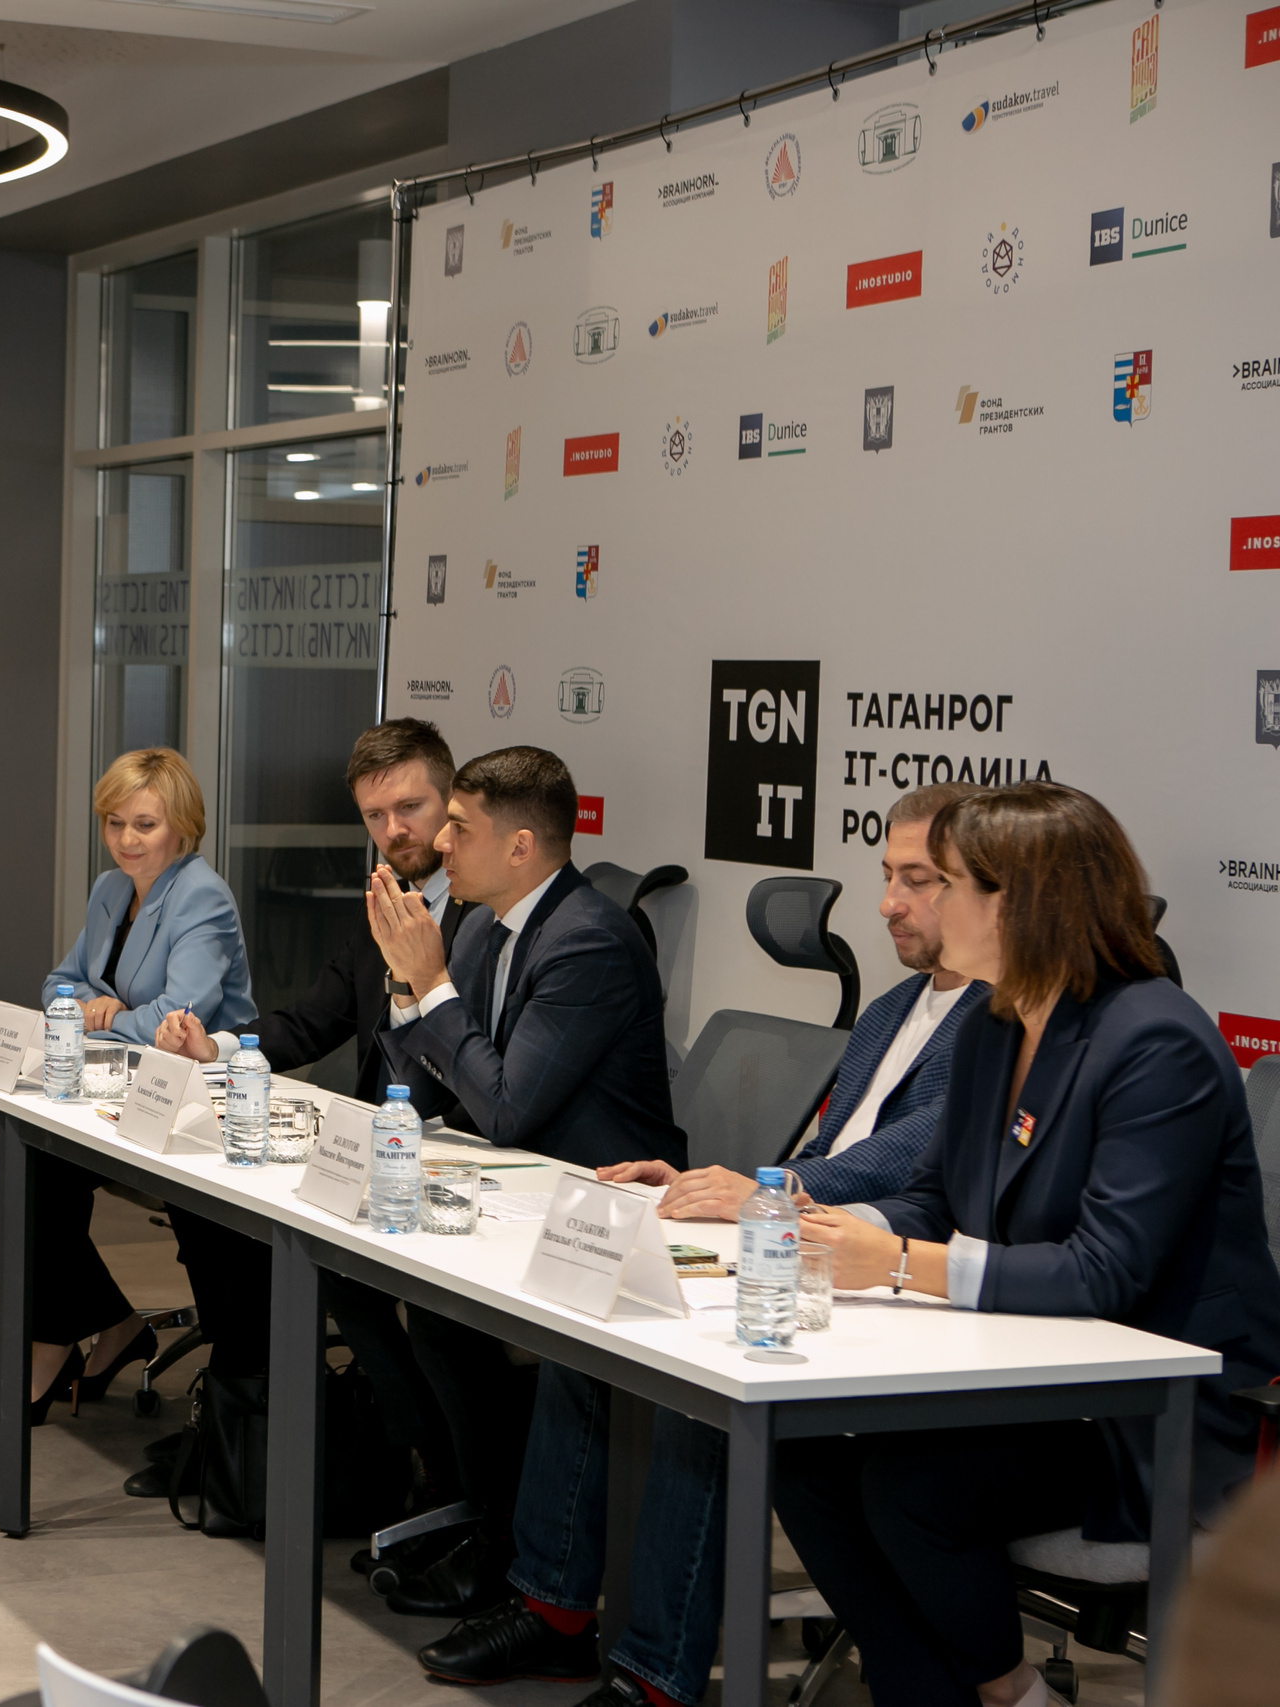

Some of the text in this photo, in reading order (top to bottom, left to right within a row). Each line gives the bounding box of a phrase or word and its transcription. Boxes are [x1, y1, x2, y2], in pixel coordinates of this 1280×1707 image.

[1258, 27, 1280, 44] .IN
[991, 80, 1060, 112] sudakov.travel
[1094, 212, 1188, 248] IBS Dunice
[855, 269, 913, 291] .INOSTUDIO
[670, 302, 719, 323] sudakov.travel
[979, 405, 1045, 422] ПРЕЗИДЕНТСКИХ
[980, 398, 1003, 409] ФОНД
[741, 420, 808, 445] IBS Dunice
[979, 423, 1013, 436] ГРАНТОВ
[570, 448, 613, 462] .INOSTUDIO
[722, 688, 807, 745] TGN
[846, 691, 1014, 732] ТАГАНРОГ
[756, 783, 803, 840] IT
[842, 808, 891, 847] РО
[1228, 880, 1279, 893] АССОЦИАЦИЯ
[1230, 1035, 1280, 1053] .INOST
[565, 1216, 611, 1241] СУДАКОВА
